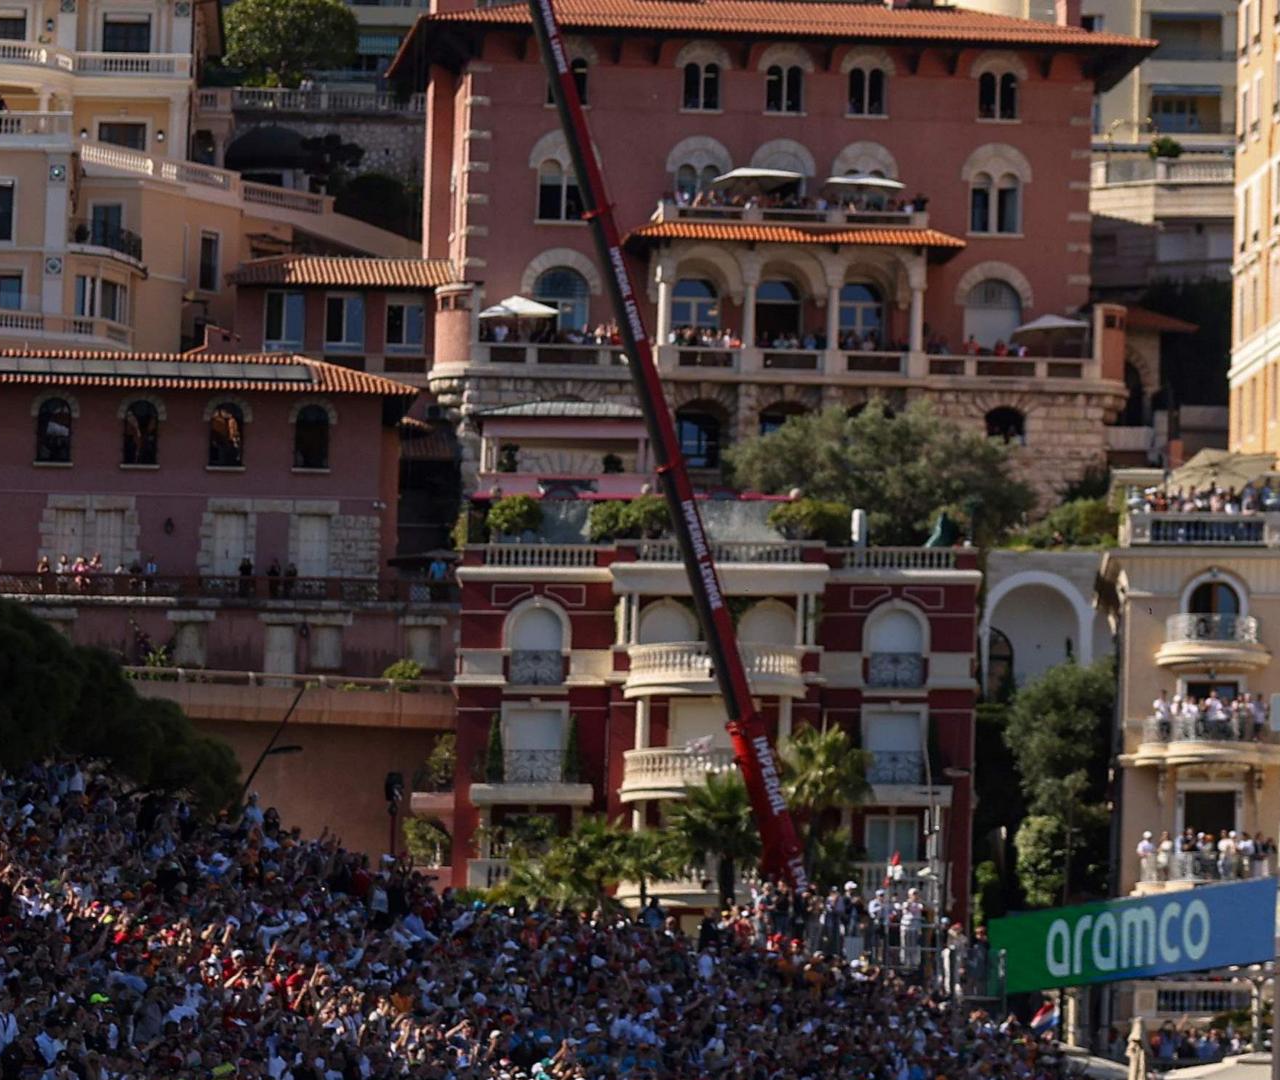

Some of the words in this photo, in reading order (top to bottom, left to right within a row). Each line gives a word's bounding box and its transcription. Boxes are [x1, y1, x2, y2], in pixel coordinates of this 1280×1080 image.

[681, 500, 708, 557] IMPERIAL
[699, 555, 723, 610] LEVAGE
[753, 736, 786, 816] IMPERIAL
[1046, 899, 1211, 977] aramco
